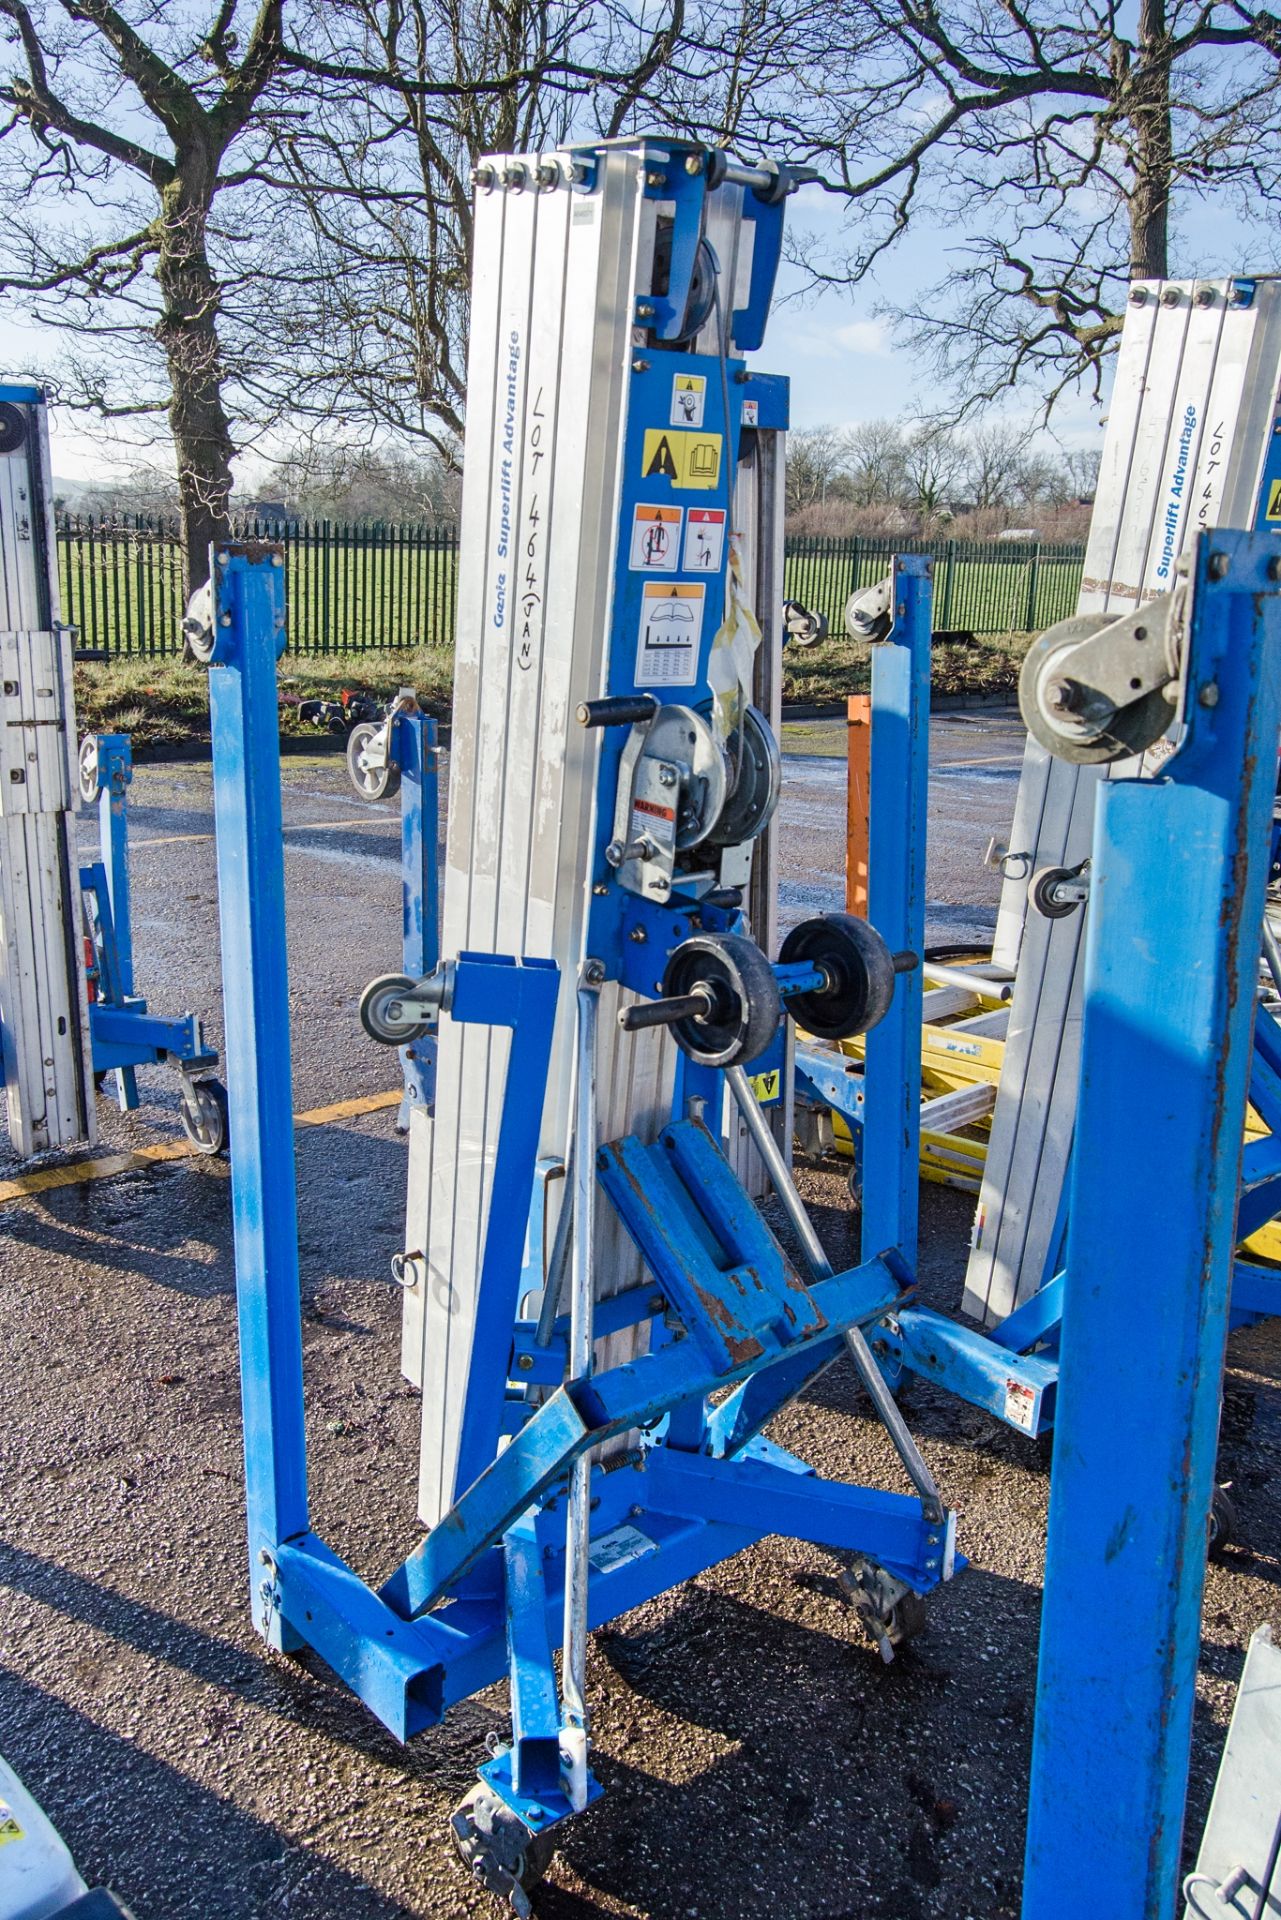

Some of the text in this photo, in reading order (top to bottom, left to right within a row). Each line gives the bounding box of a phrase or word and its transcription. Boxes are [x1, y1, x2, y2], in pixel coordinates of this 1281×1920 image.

[494, 330, 520, 628] Genie Superlift Advantage
[531, 386, 545, 476] LOT
[1157, 502, 1180, 579] Superlift
[1171, 404, 1197, 498] Advantage
[1198, 421, 1225, 529] LOT 46
